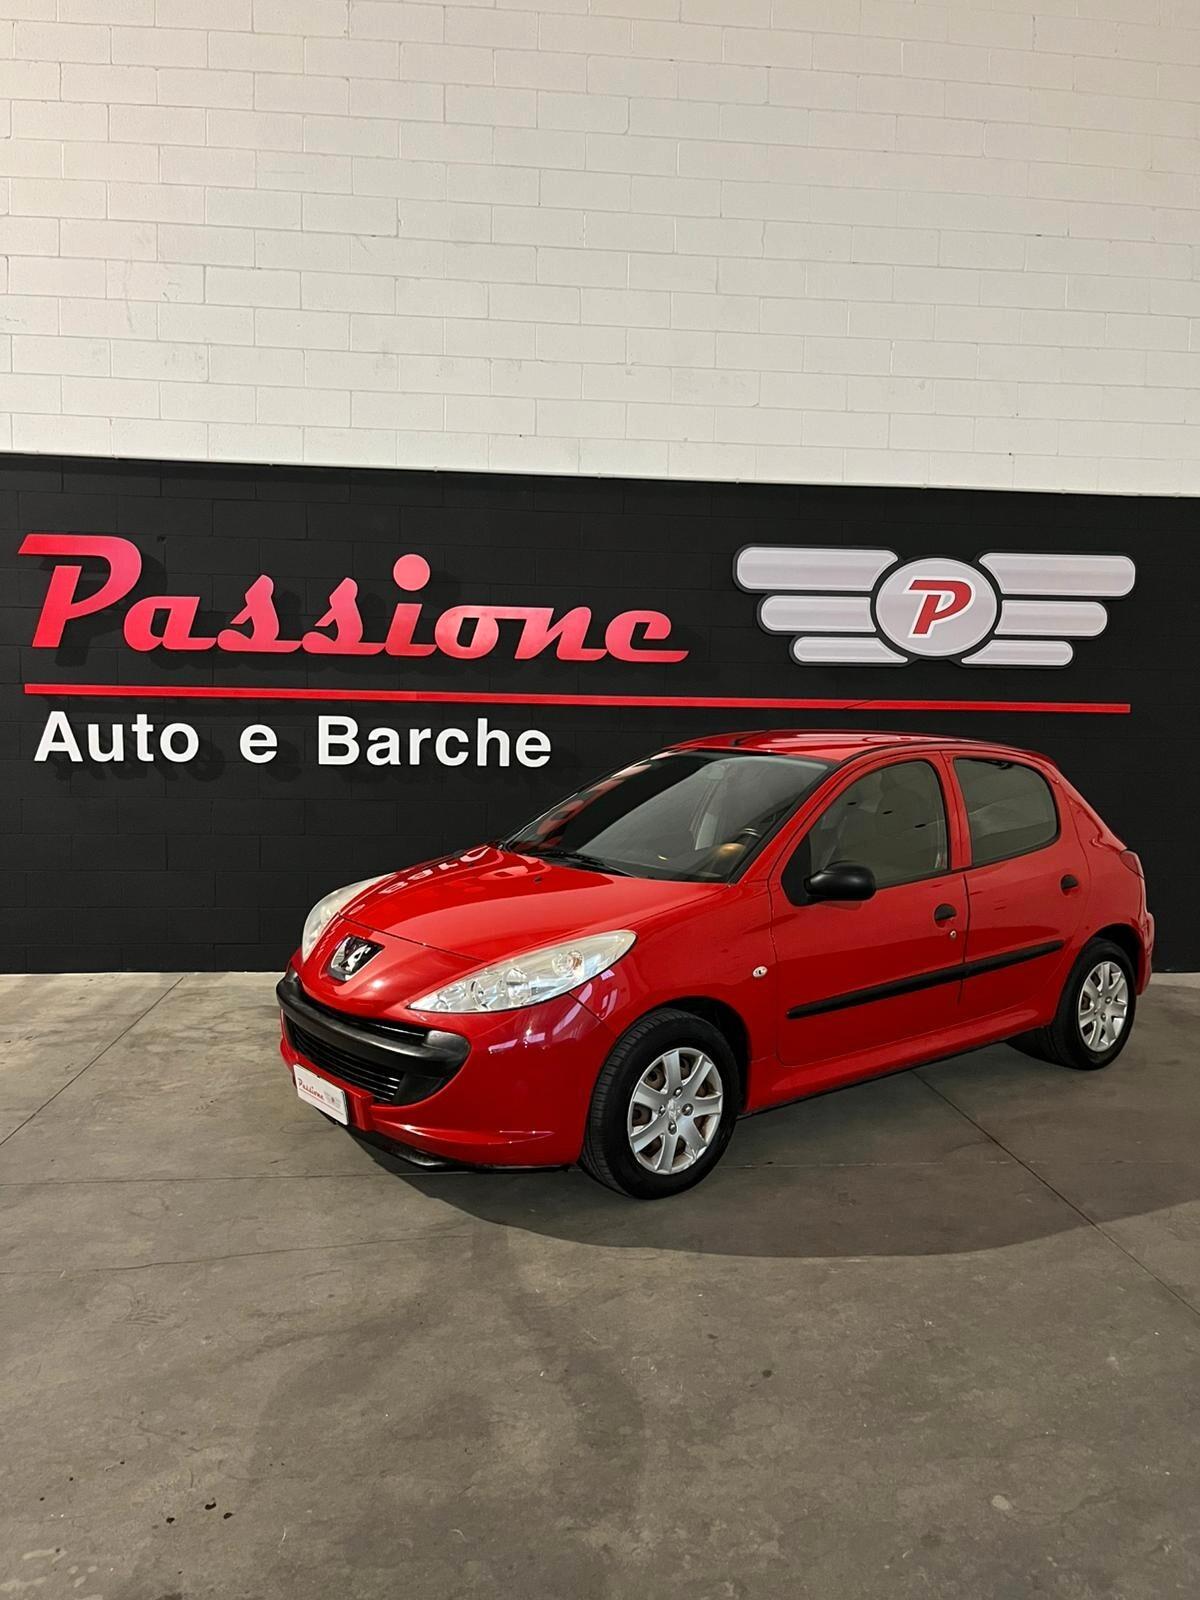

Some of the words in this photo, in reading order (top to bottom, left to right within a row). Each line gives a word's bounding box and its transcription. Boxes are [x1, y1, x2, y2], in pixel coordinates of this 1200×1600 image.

[18, 533, 688, 663] Passione
[908, 577, 973, 637] P
[33, 710, 200, 763] Auto
[238, 723, 279, 764] e
[317, 714, 552, 768] Barche
